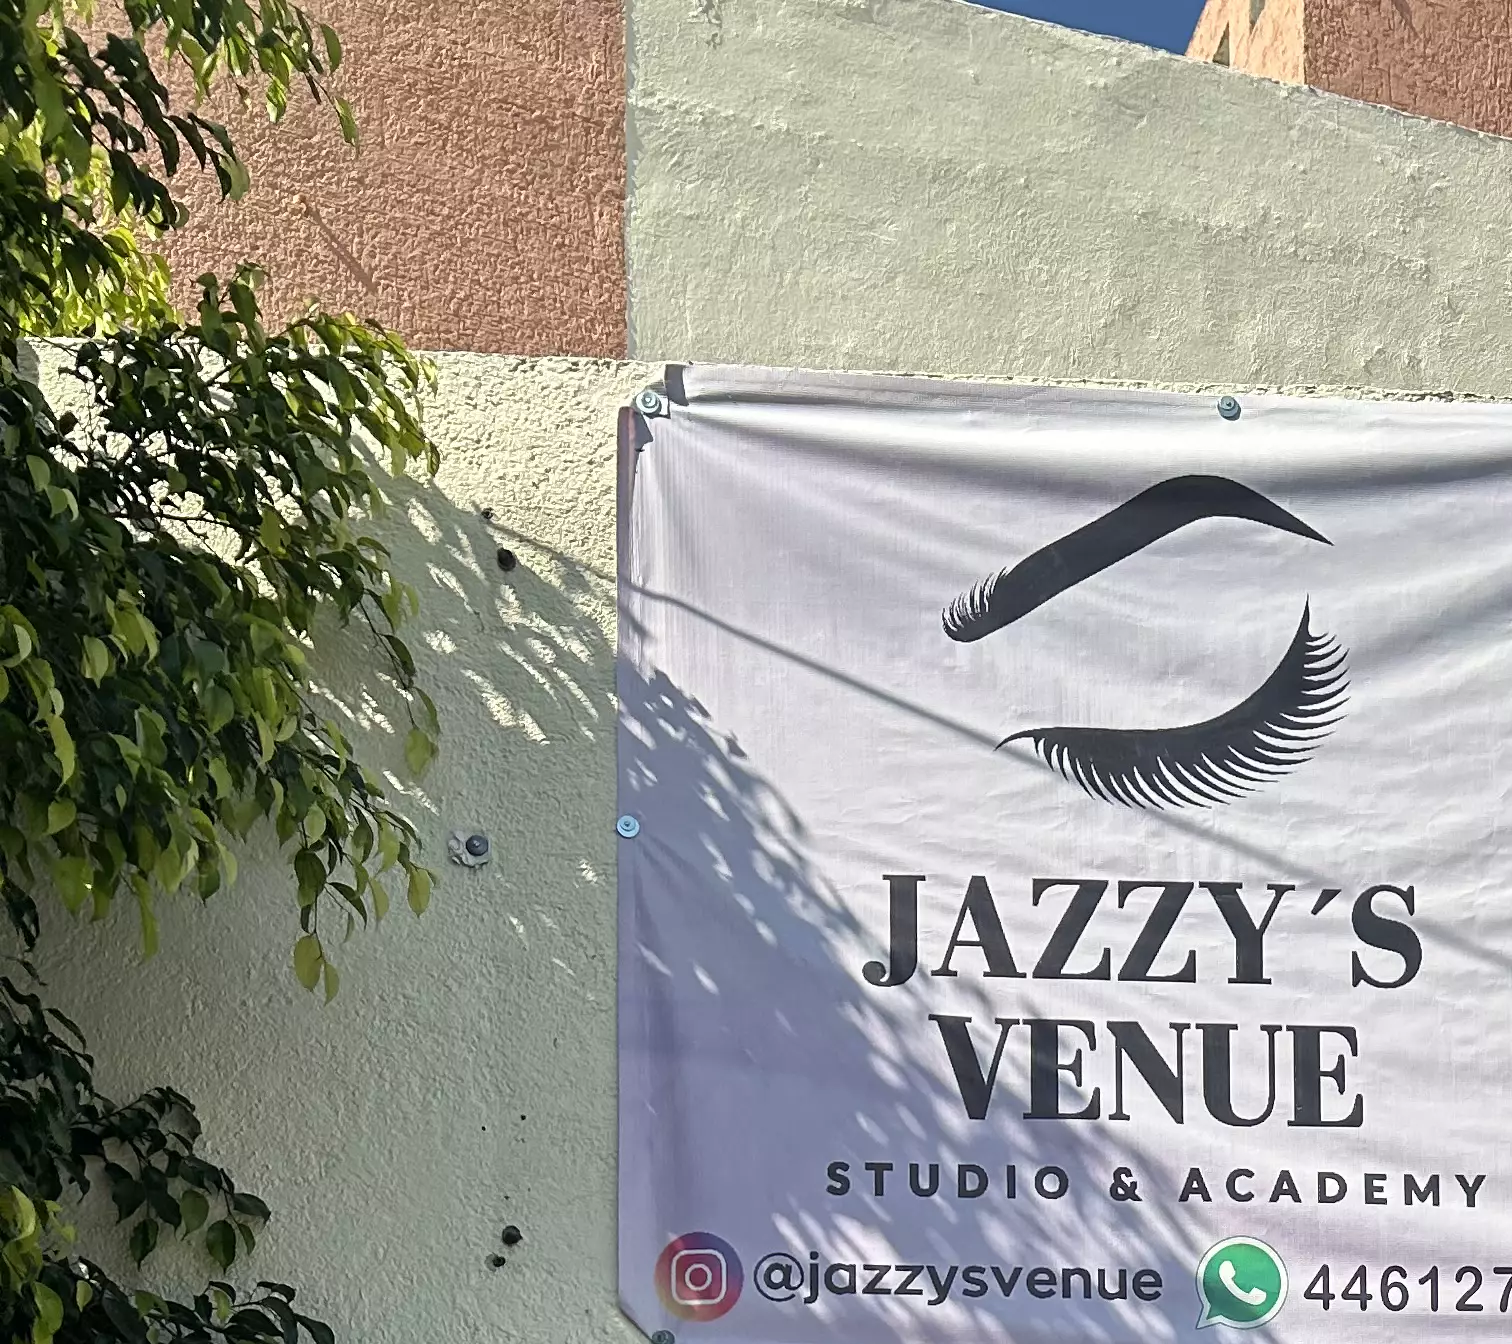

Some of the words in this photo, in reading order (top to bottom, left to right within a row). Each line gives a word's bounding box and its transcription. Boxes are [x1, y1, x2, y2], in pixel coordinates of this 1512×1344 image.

[928, 1013, 1364, 1128] VENUE
[825, 1161, 1069, 1199] STUDIO
[1109, 1166, 1143, 1202] &
[1178, 1167, 1487, 1208] ACADEMY
[753, 1250, 1163, 1305] @jazzysvenue
